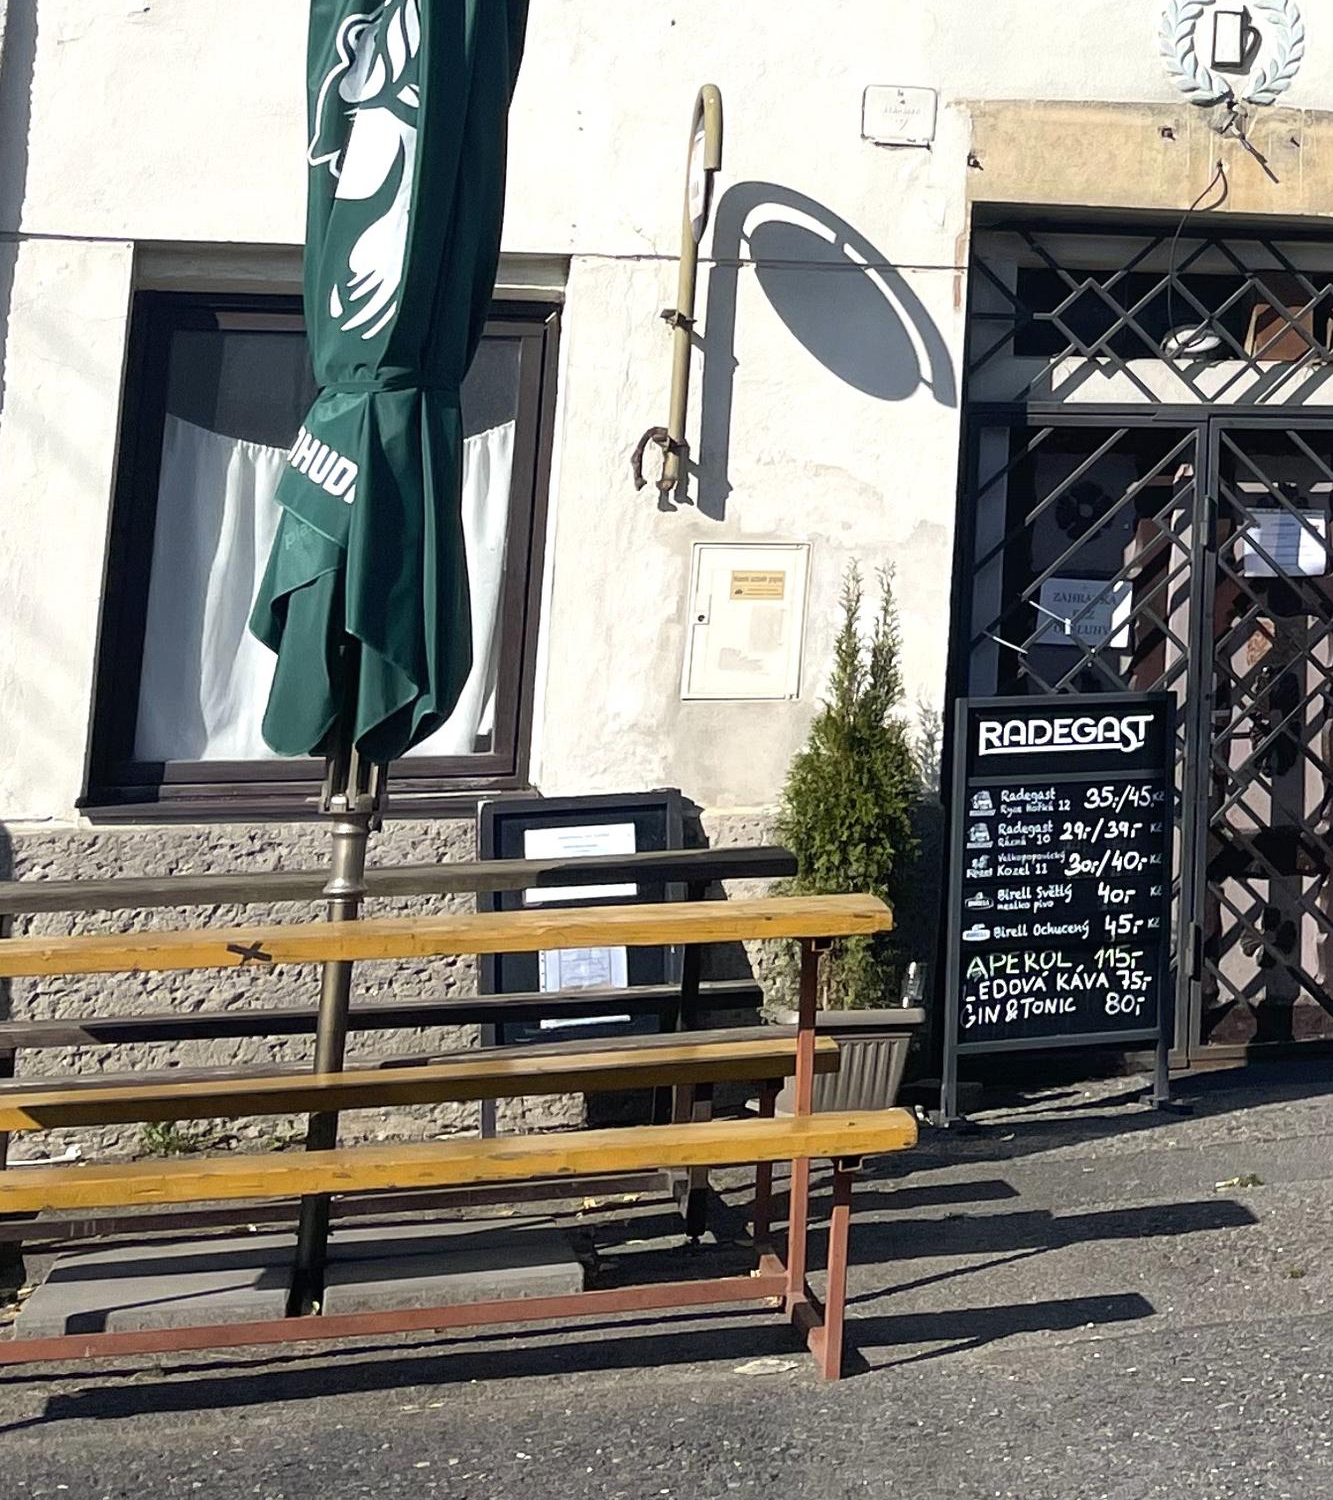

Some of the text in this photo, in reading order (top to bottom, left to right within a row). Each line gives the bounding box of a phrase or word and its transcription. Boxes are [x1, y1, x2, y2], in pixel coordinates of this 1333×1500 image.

[978, 714, 1155, 756] RADEGAST
[1001, 787, 1057, 805] Radegast
[1058, 799, 1071, 812] 12
[998, 820, 1054, 839] Radegast
[1036, 833, 1051, 846] 10
[997, 862, 1031, 877] Kozel
[1035, 862, 1049, 876] 11
[966, 950, 1073, 981] APEROL
[1056, 964, 1110, 992] KÁVA
[960, 1002, 1000, 1029] GIN
